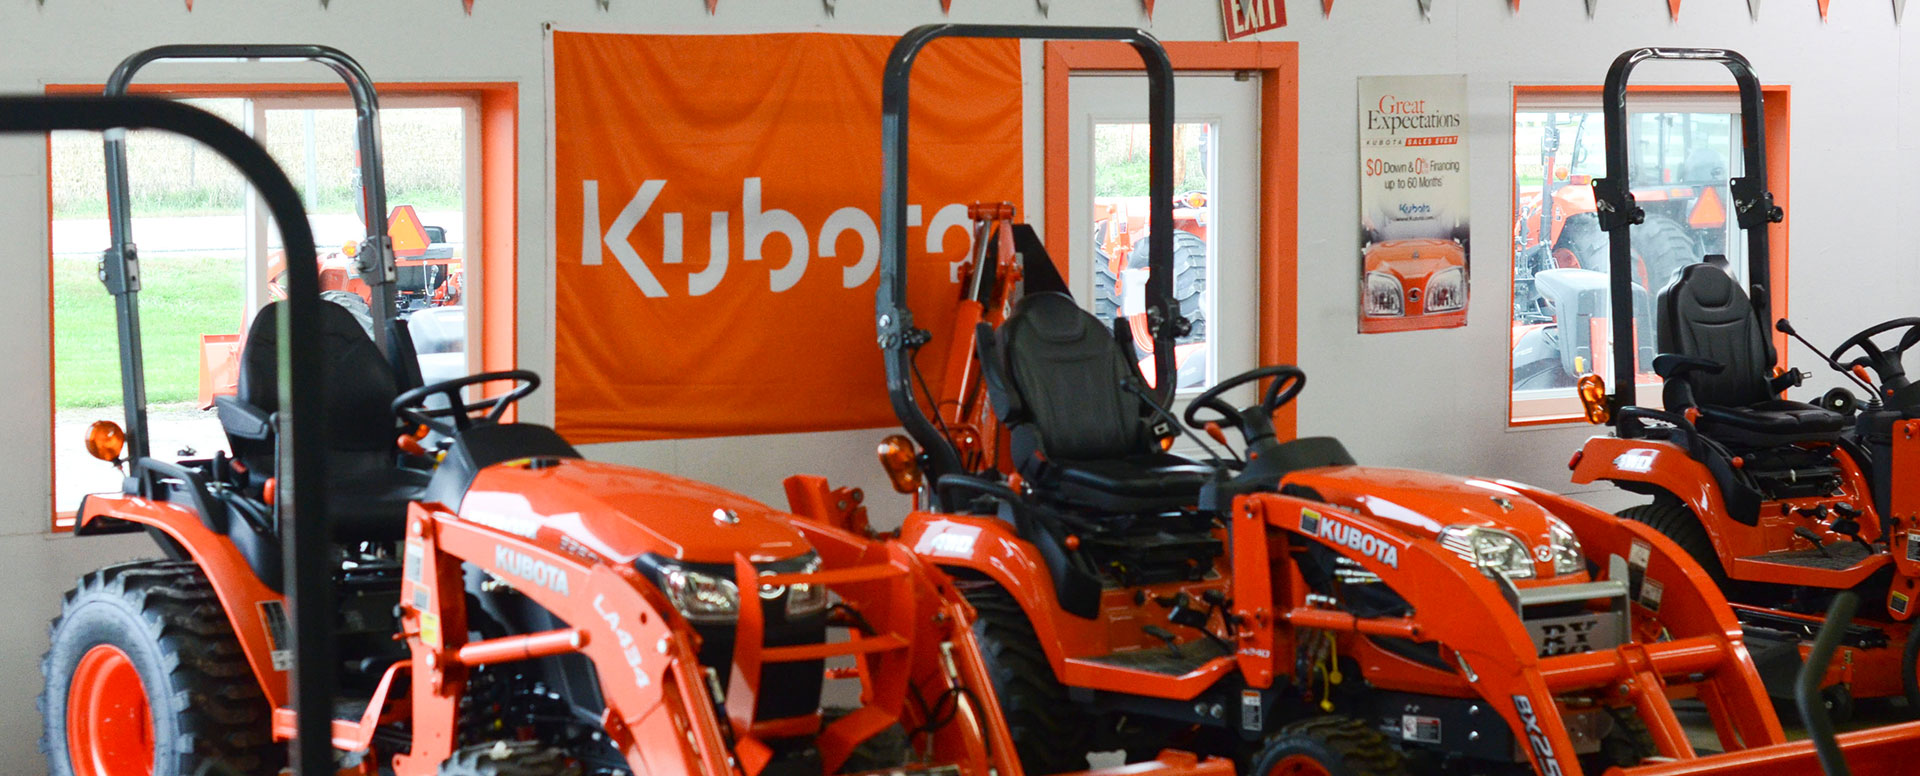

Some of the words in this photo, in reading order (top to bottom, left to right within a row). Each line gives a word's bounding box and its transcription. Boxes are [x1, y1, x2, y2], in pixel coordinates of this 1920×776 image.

[1367, 110, 1460, 135] Expectations
[1379, 95, 1425, 115] Great
[1366, 158, 1383, 176] $0
[1383, 162, 1407, 174] Down
[1430, 160, 1460, 173] Financing
[1384, 180, 1395, 191] up
[1397, 178, 1405, 189] to
[1407, 177, 1417, 188] 60
[581, 176, 978, 298] Kuboa
[1320, 516, 1399, 569] KUBOTA
[495, 543, 570, 597] KUBOTA
[593, 593, 650, 689] LA434
